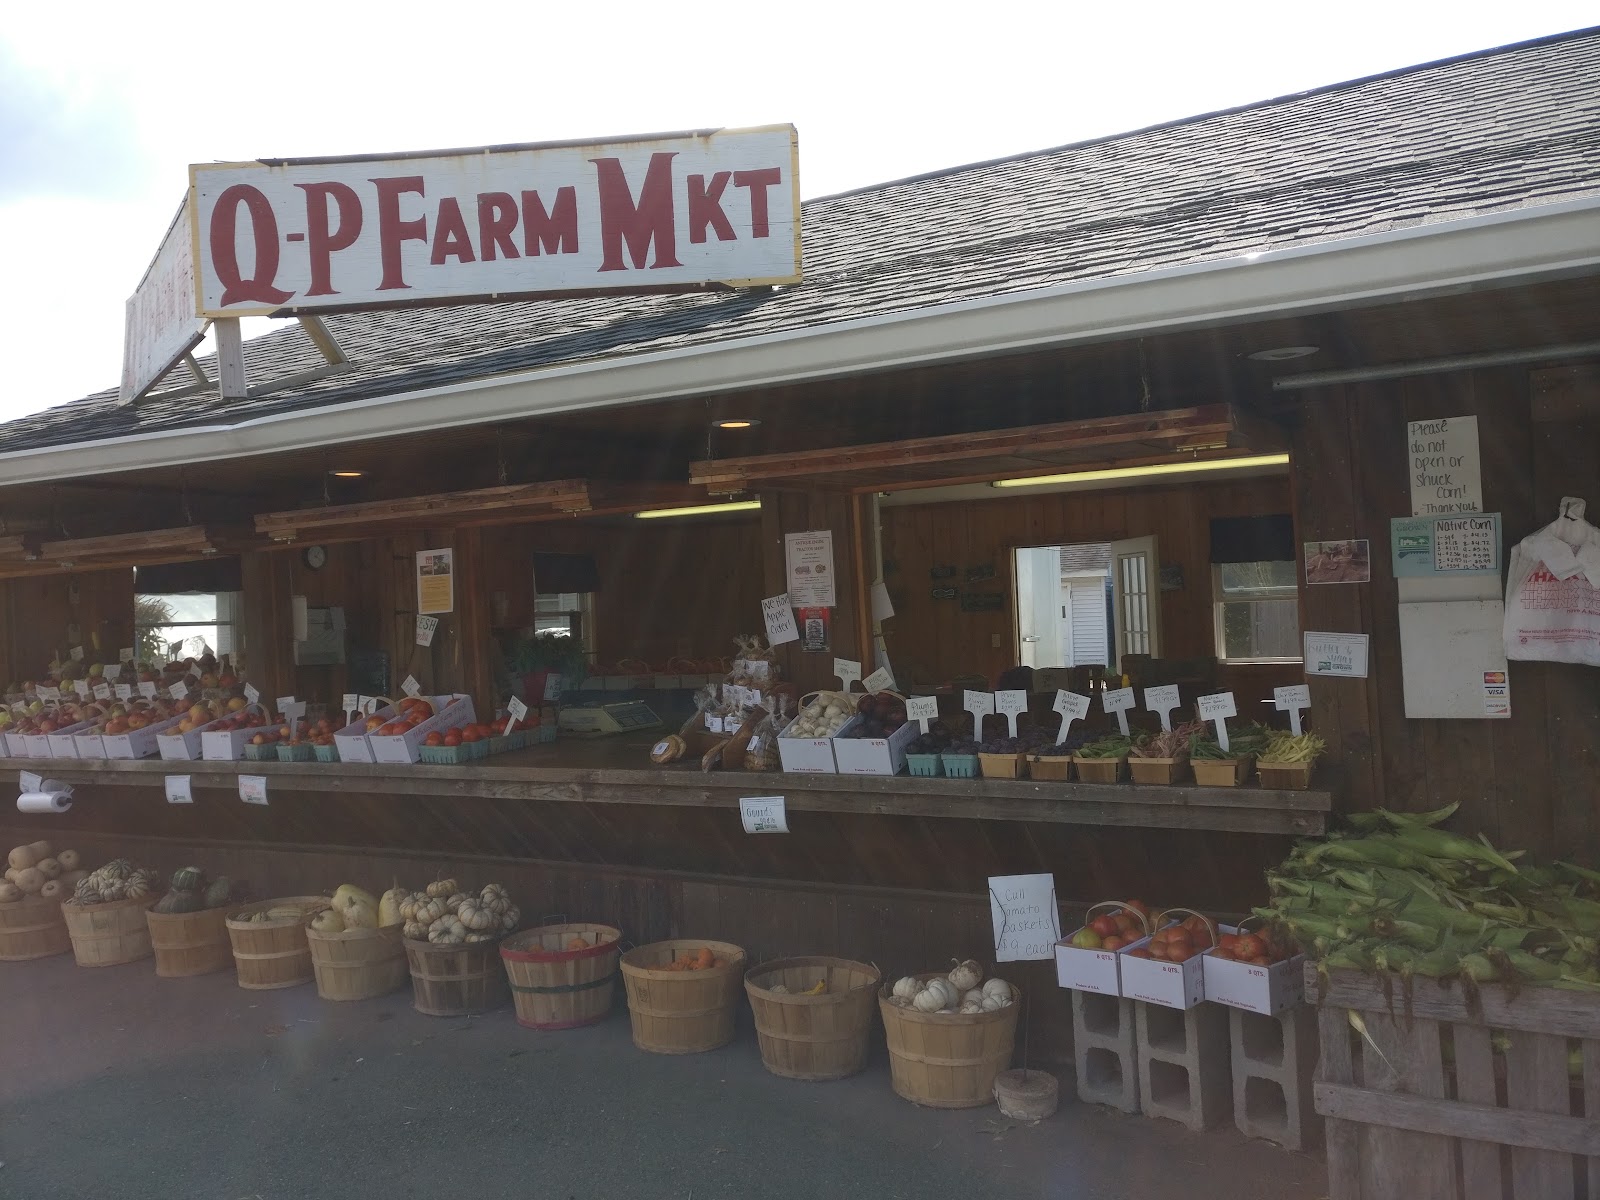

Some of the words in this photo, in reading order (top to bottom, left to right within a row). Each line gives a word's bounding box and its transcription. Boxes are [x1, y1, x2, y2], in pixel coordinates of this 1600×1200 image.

[209, 181, 364, 308] Q-P
[367, 175, 579, 291] FARM
[587, 151, 782, 273] MKT
[1411, 422, 1448, 436] Please
[1410, 440, 1425, 454] do
[1427, 439, 1447, 453] not
[1415, 456, 1445, 471] open
[1449, 455, 1465, 468] or
[1415, 472, 1453, 488] shuck
[1436, 519, 1468, 532] Native
[1470, 518, 1492, 531] Corn
[762, 599, 774, 611] We
[766, 608, 786, 623] Apple
[911, 701, 934, 711] Plums
[1005, 888, 1025, 902] Cull
[1167, 966, 1180, 974] QTS.
[1253, 970, 1266, 978] QTS.
